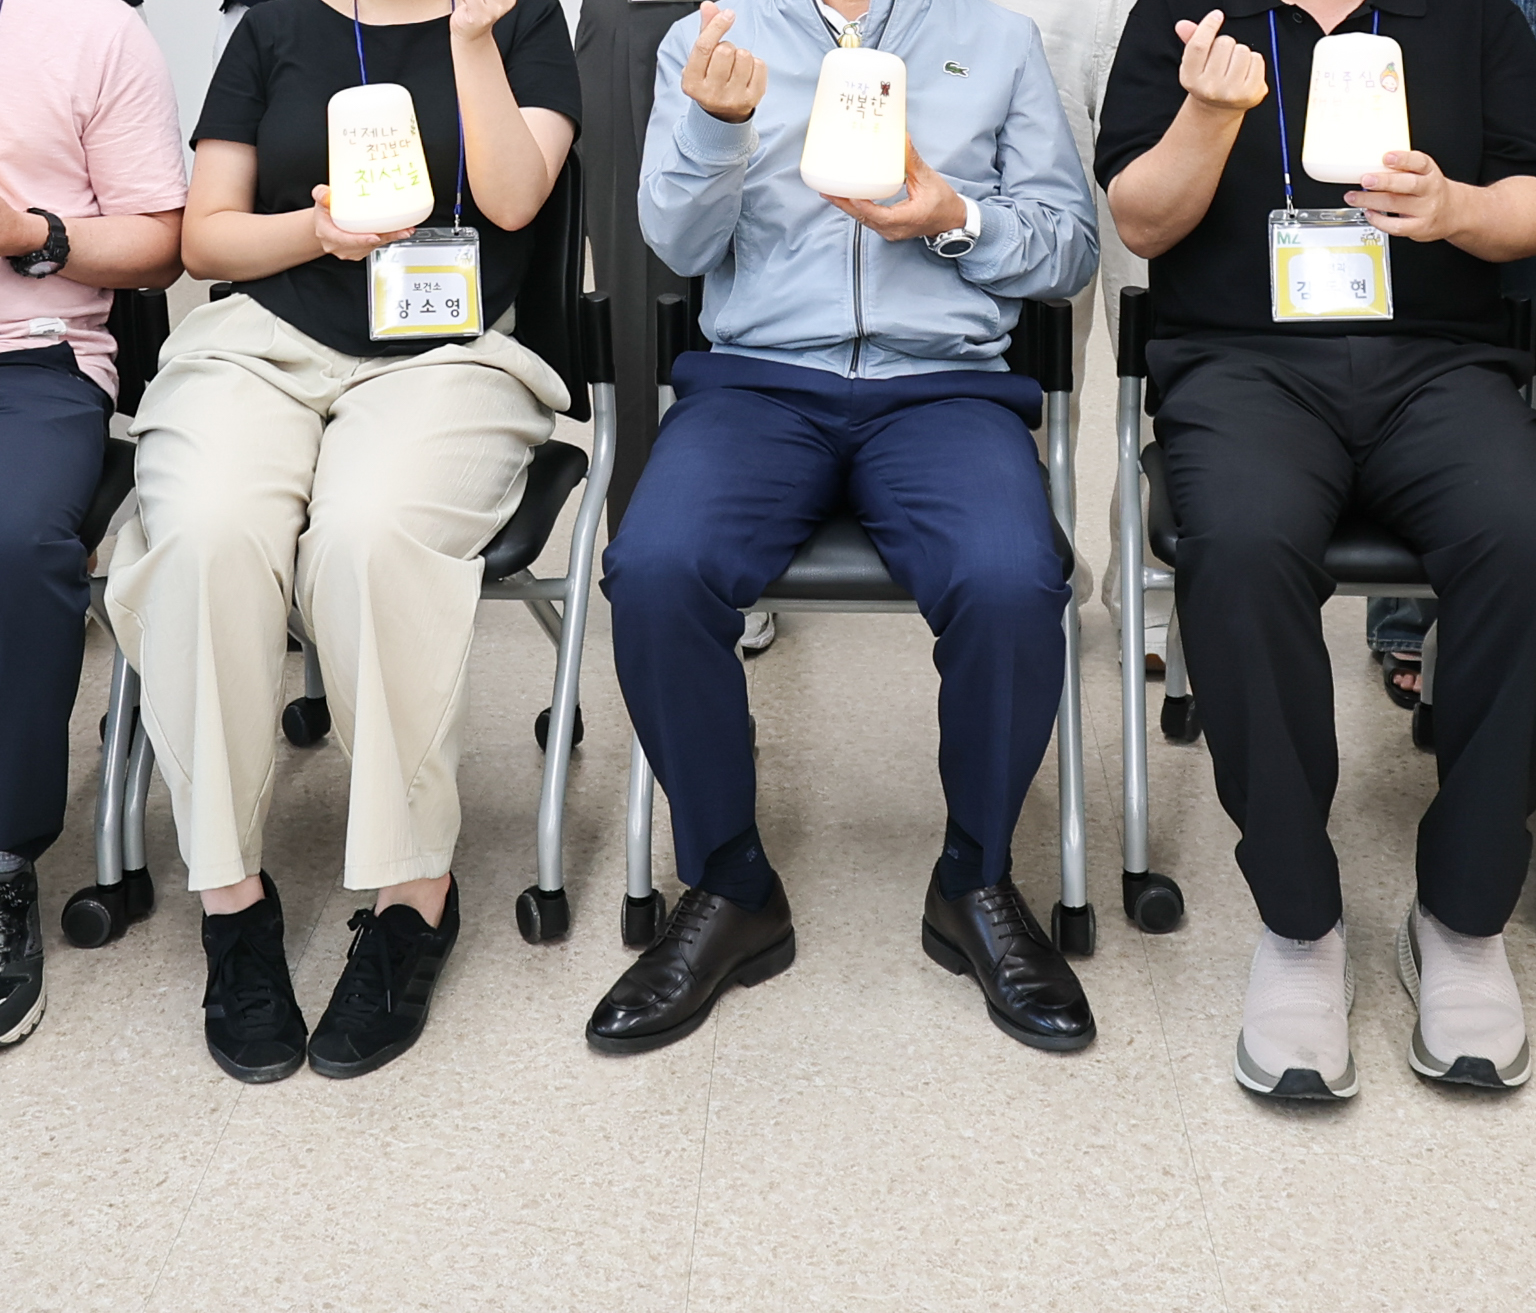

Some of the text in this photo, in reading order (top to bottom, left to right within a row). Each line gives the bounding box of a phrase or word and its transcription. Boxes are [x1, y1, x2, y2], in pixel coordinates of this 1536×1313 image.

[839, 93, 887, 119] 행복한
[342, 126, 398, 145] 언제나
[365, 139, 412, 161] 최고보다
[353, 162, 421, 197] 최선을
[412, 282, 442, 293] 보건소
